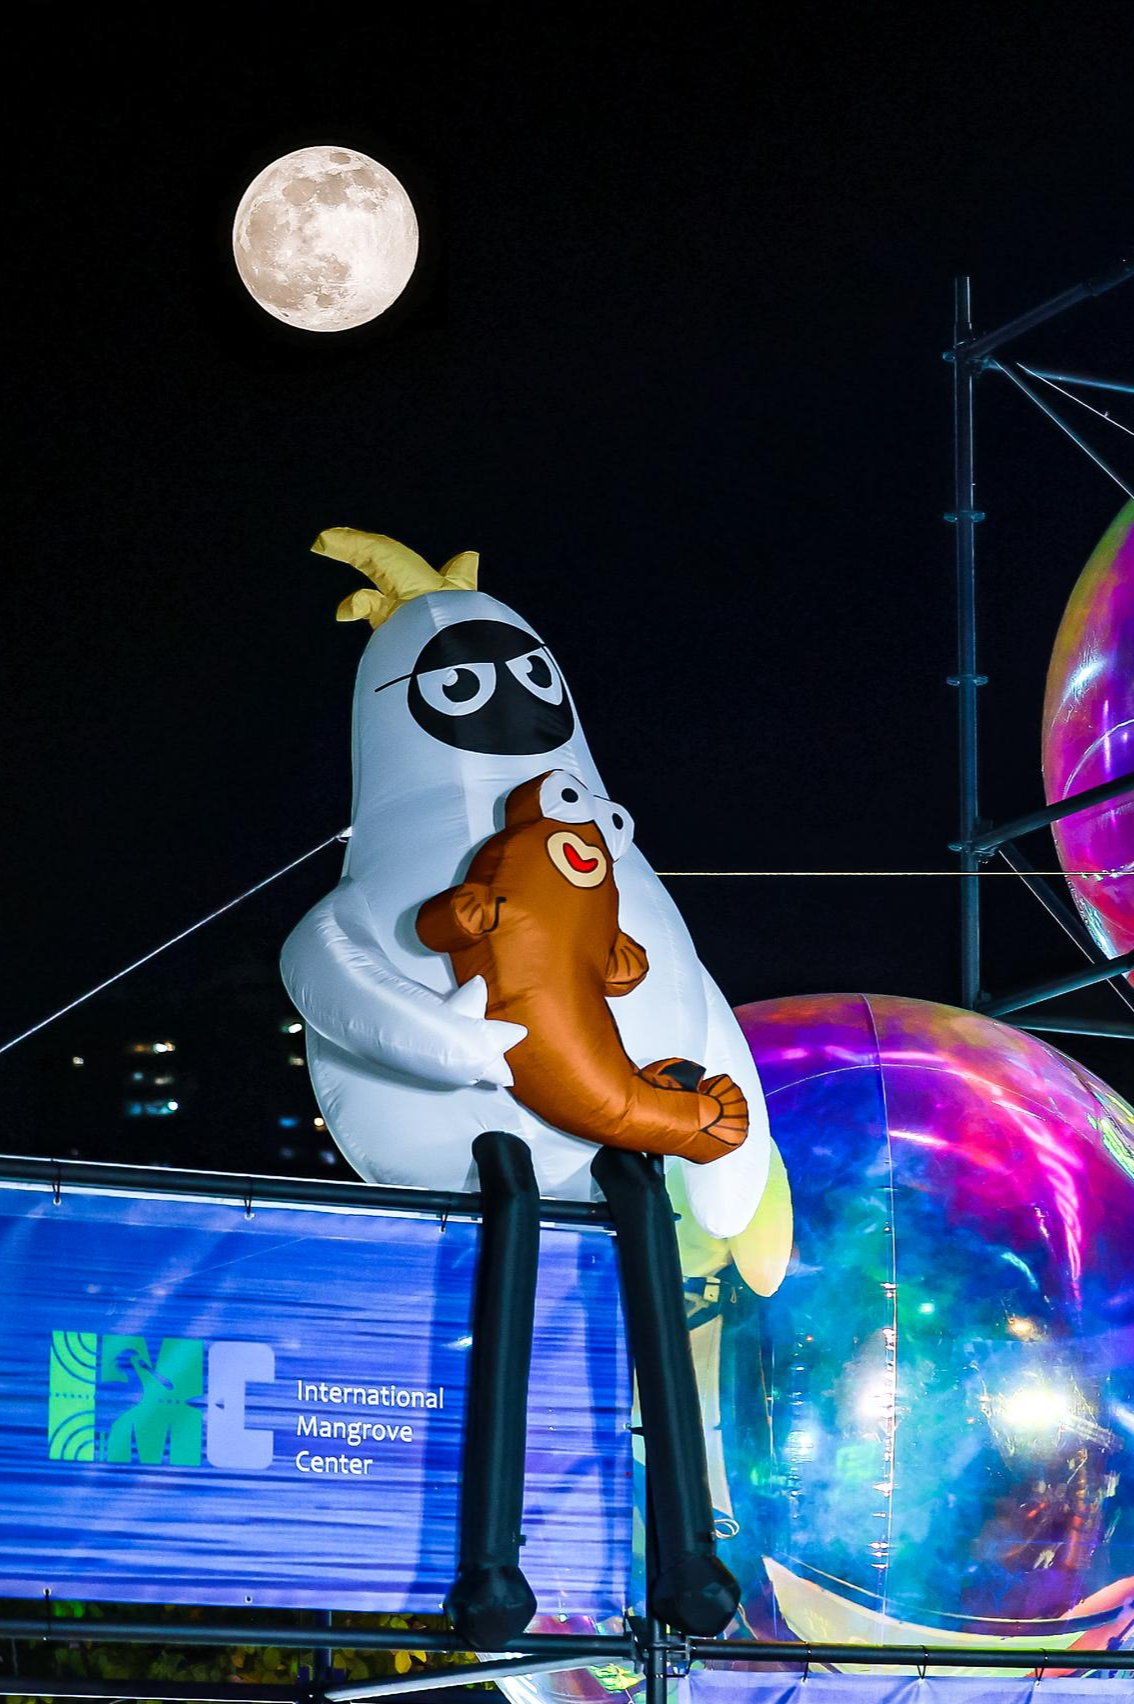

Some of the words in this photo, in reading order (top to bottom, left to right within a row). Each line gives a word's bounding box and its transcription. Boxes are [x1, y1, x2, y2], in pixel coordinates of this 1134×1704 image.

[297, 1380, 444, 1410] International
[297, 1415, 413, 1446] Mangrove
[295, 1450, 373, 1475] Center
